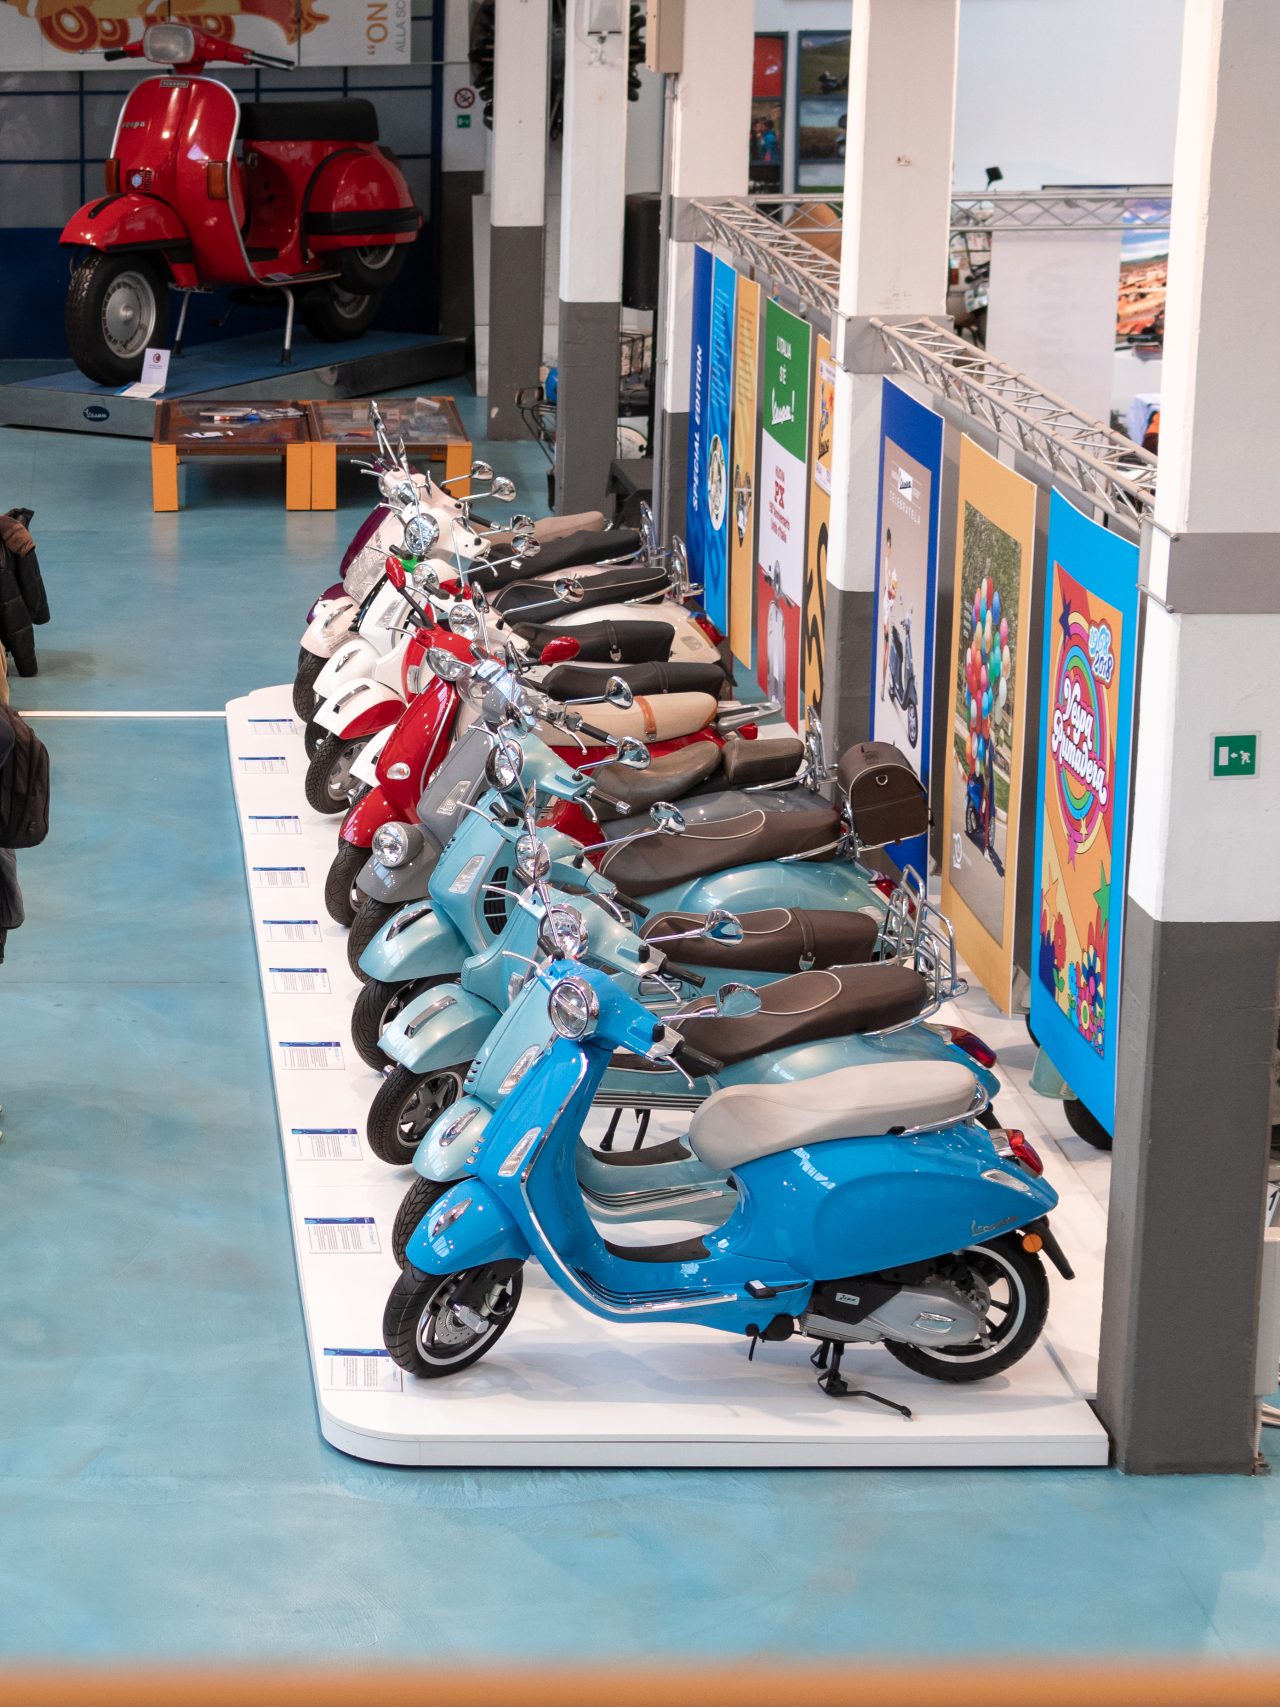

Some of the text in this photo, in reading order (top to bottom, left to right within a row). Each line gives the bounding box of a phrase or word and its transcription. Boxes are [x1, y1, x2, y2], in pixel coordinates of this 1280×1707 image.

[692, 344, 703, 511] SPECIAL EDITION
[1094, 650, 1114, 681] 2018
[1051, 707, 1108, 806] Primavera
[1062, 677, 1095, 751] Vespa
